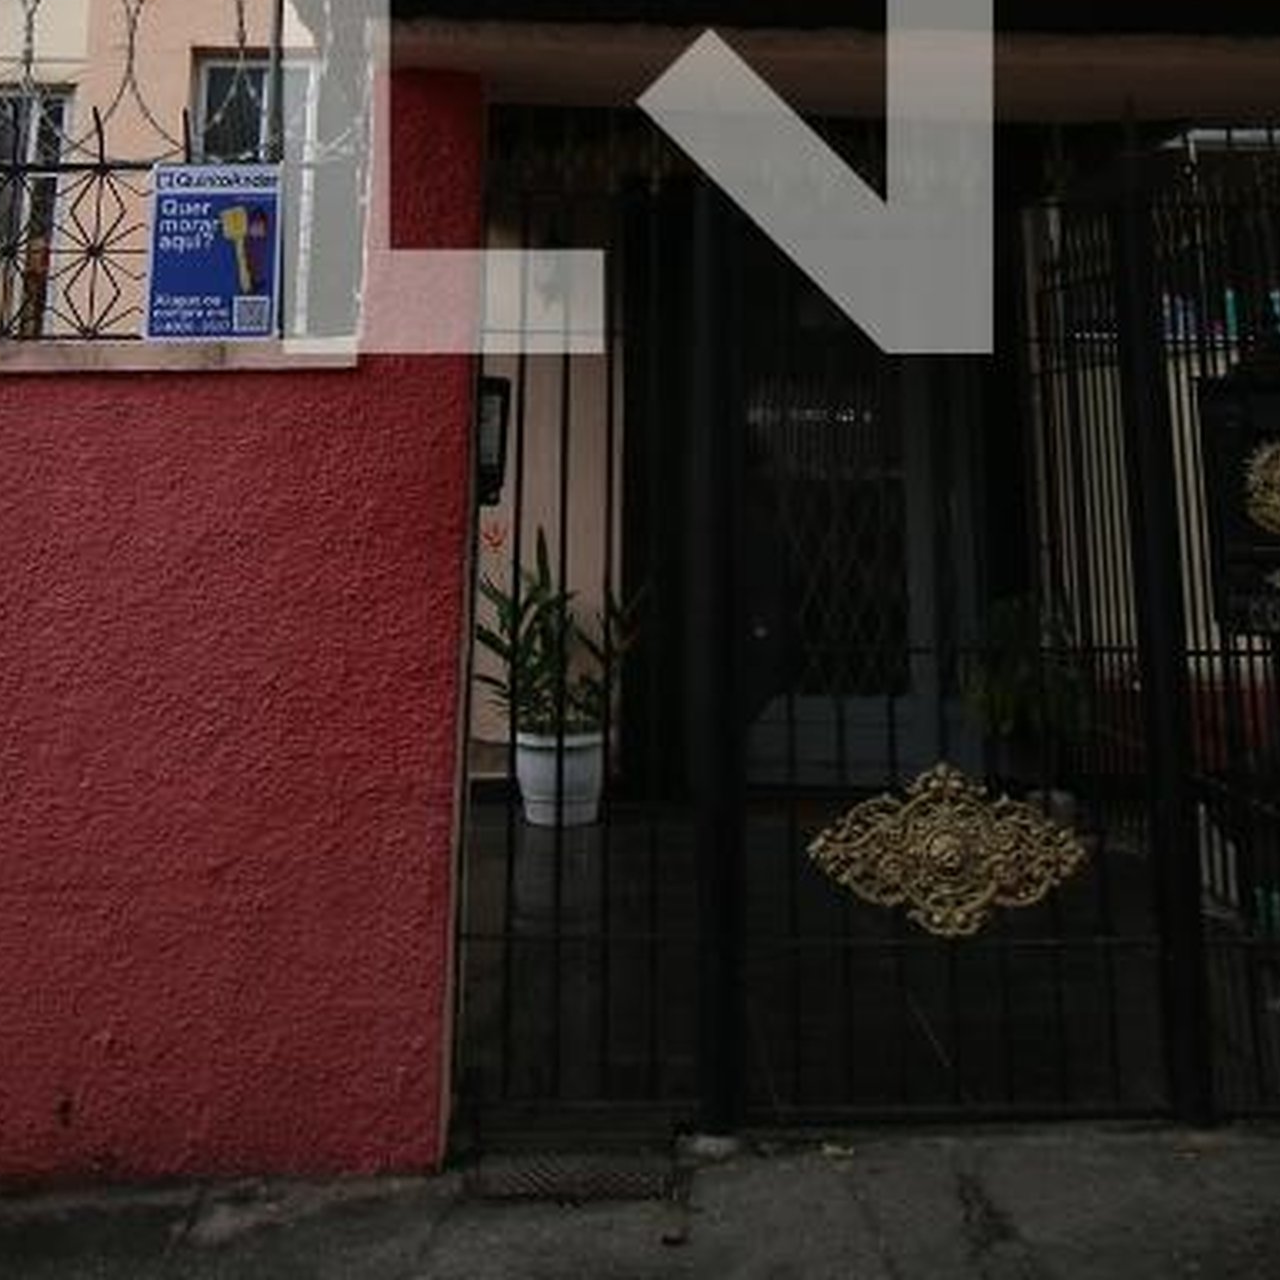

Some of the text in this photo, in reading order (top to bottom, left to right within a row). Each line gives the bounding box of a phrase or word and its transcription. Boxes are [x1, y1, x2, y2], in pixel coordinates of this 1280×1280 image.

[161, 198, 211, 216] Quer
[159, 218, 219, 232] morar
[159, 232, 215, 252] aqui?
